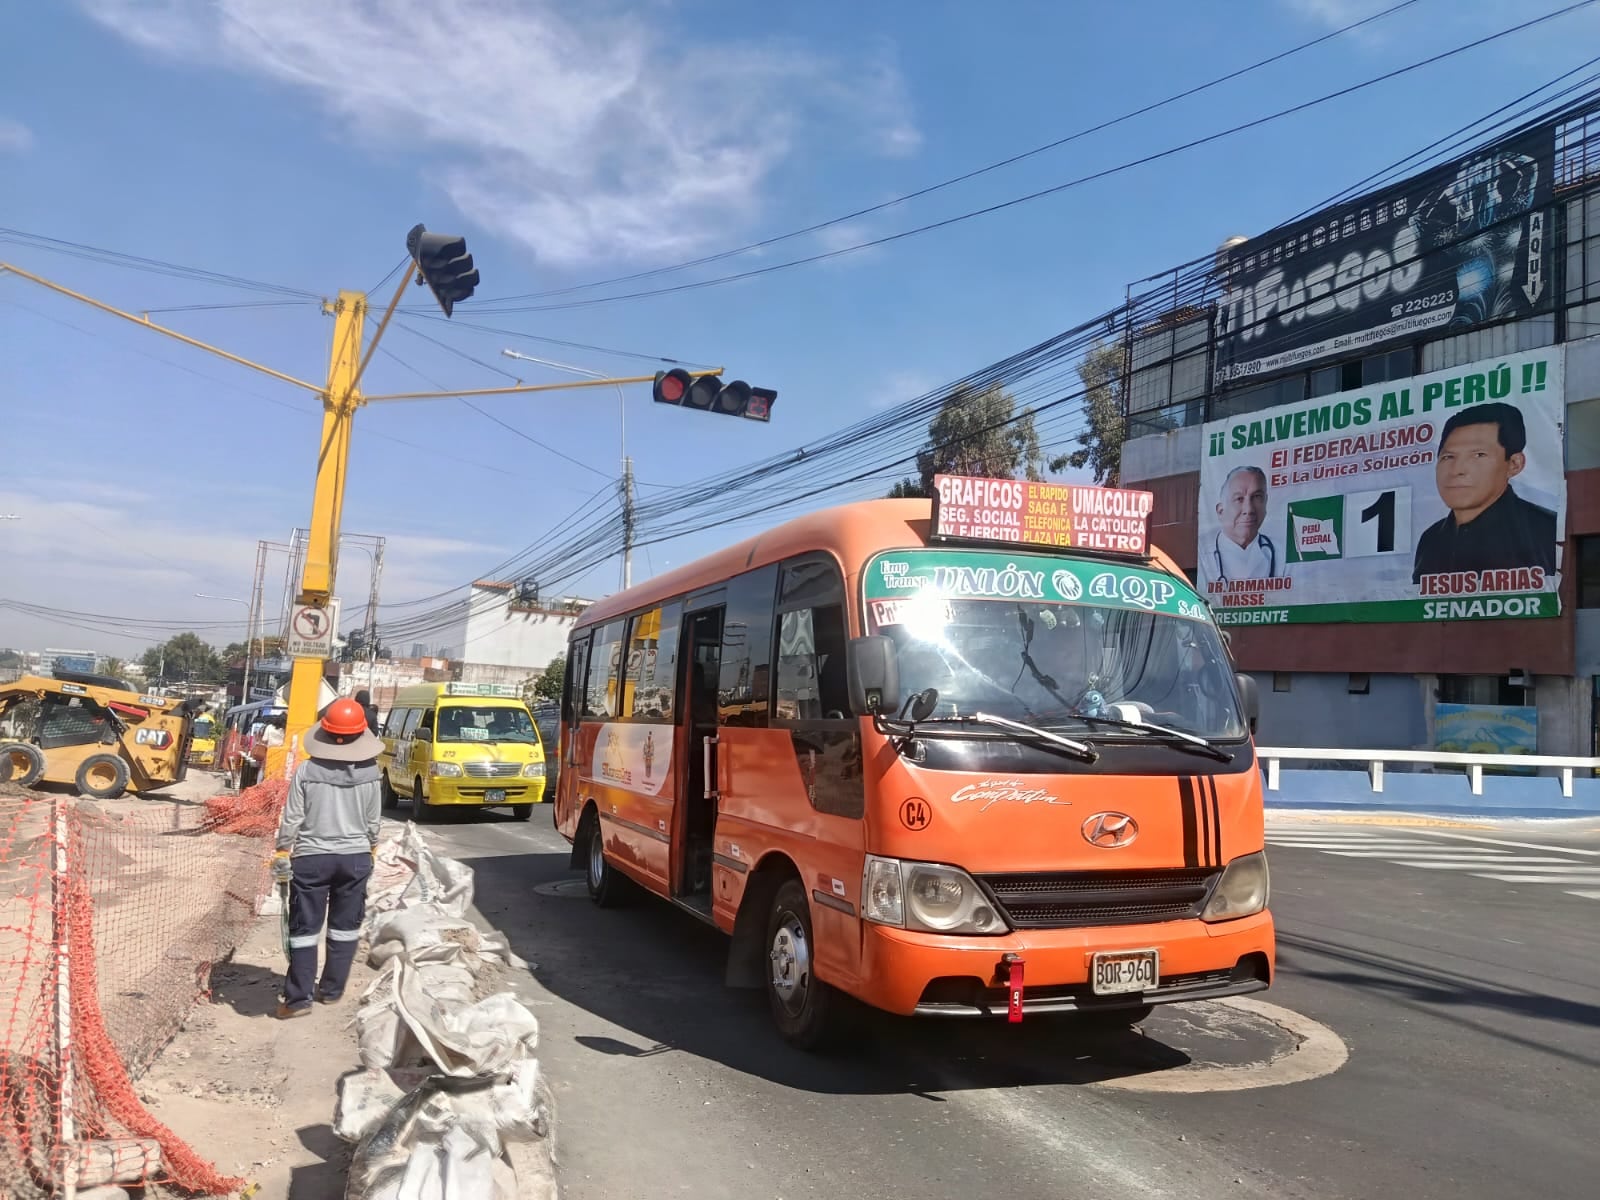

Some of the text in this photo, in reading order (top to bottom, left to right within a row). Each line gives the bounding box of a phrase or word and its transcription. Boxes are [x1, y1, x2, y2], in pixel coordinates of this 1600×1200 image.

[1405, 290, 1454, 312] 226223
[1231, 398, 1371, 450] SALVEMOS
[1379, 389, 1414, 420] AL
[1422, 363, 1511, 413] PERÚ
[1293, 424, 1434, 465] FEDERALISMO
[1271, 451, 1433, 487] Es La Única Solucón
[939, 477, 1022, 509] GRAFICOS
[1029, 486, 1068, 501] EL RAPIDO
[1073, 488, 1149, 518] UMACOLLO
[939, 507, 1020, 526] SEG. SOCIAL
[1028, 501, 1068, 516] SAGA F.
[1024, 516, 1071, 531] TELEFONICA
[1074, 517, 1145, 535] LA CATOLICA
[1361, 490, 1396, 553] 1
[959, 525, 1019, 541] EJERCITO
[1024, 530, 1071, 546] PLAZA VEA
[1077, 533, 1142, 549] FILTRO
[1302, 533, 1331, 545] FEDERAL
[934, 563, 1175, 609] UNIÓN AQP
[1208, 577, 1292, 593] DR. ARMANDO
[1420, 567, 1544, 595] JESUS ARIAS
[1223, 593, 1265, 606] MASSE
[1423, 598, 1541, 619] SENADOR
[136, 729, 166, 745] CAT
[906, 802, 925, 826] C4
[1096, 960, 1152, 985] BOR-960
